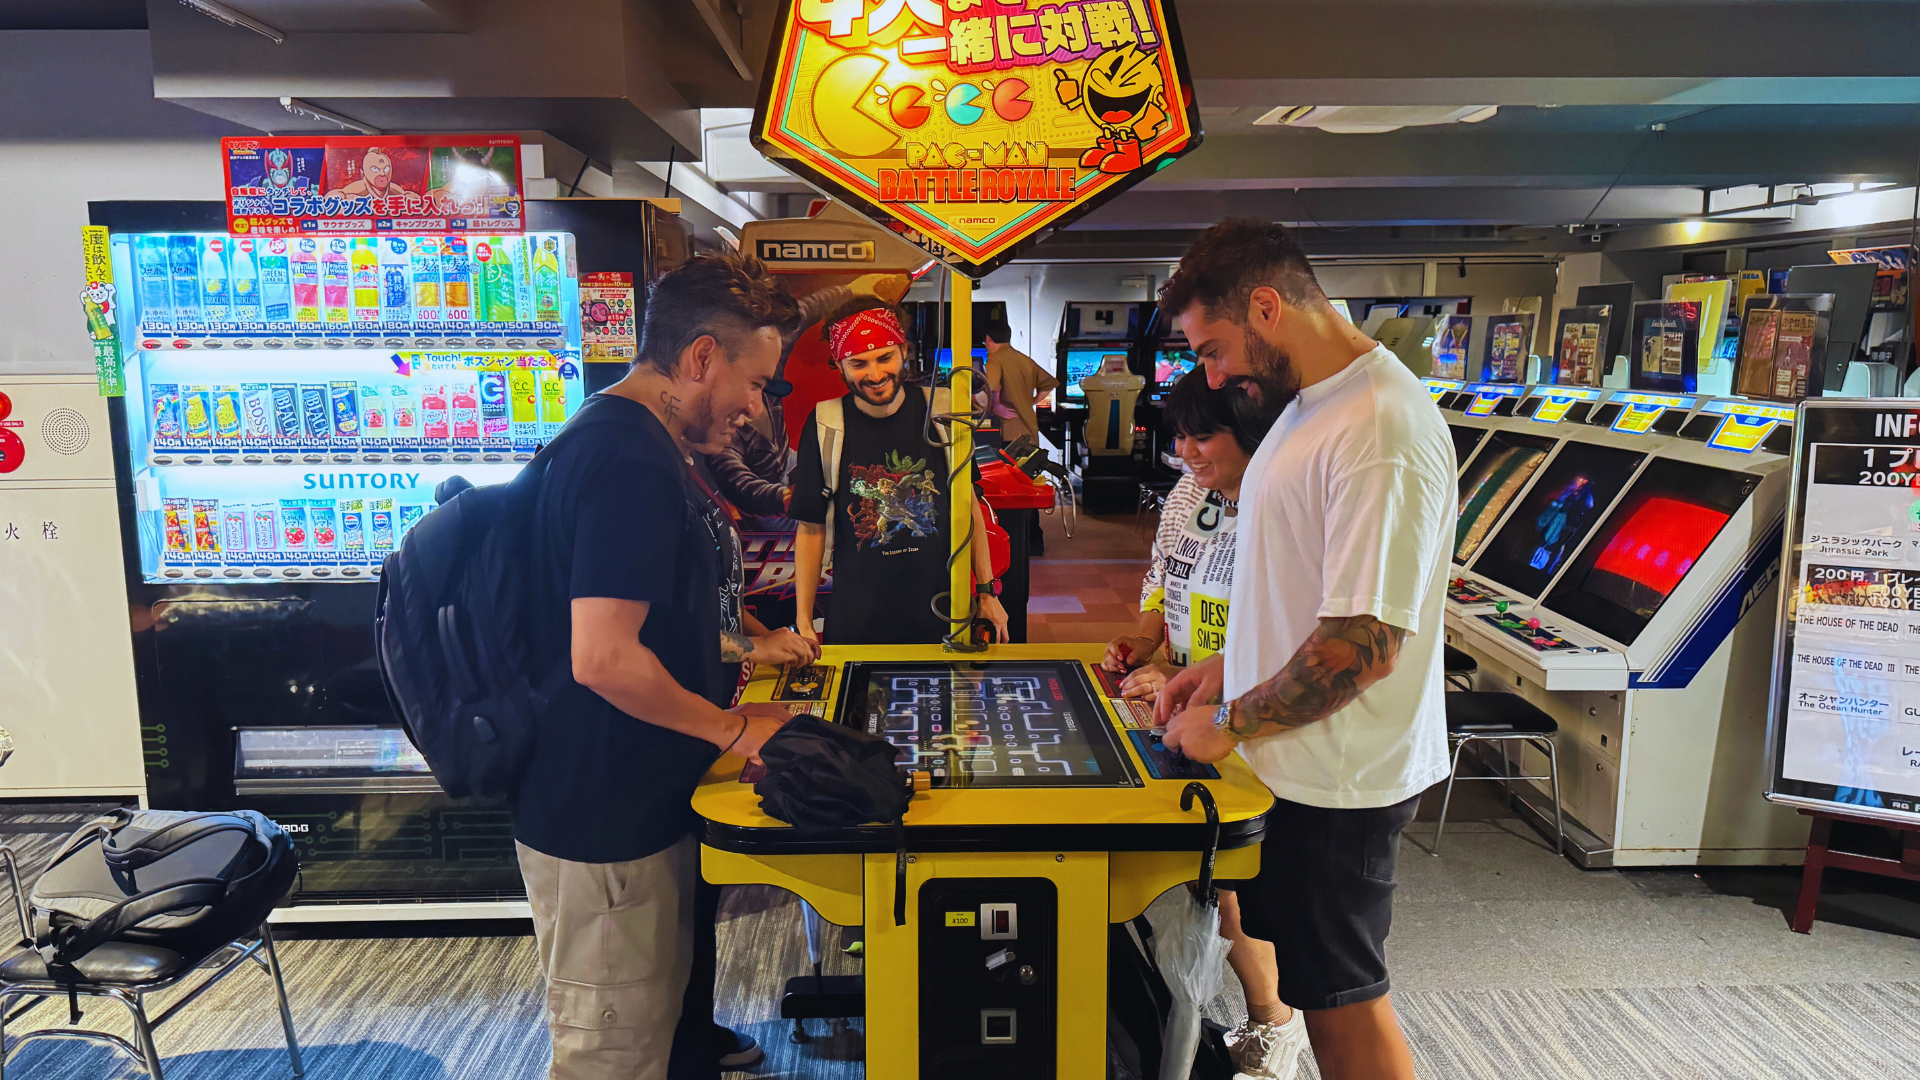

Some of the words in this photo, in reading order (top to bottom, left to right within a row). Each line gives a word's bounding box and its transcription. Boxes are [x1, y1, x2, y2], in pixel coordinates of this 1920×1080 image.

[902, 0, 1156, 64] 一緒に対戦!
[906, 141, 1049, 168] PAC-MAN
[879, 168, 979, 202] BATTLE
[980, 168, 1075, 202] ROYALE
[958, 215, 996, 225] namco
[763, 242, 867, 260] namco
[424, 353, 461, 363] Touch!
[463, 355, 552, 368] ボスジャン当たる!
[249, 397, 270, 434] BOSS
[276, 394, 299, 436] BLACK
[306, 395, 329, 437] BLACK
[1723, 403, 1759, 415] VIDEO
[1875, 413, 1920, 437] INF
[1889, 447, 1920, 468] プ
[304, 473, 420, 489] SUNTORY
[1810, 535, 1902, 548] ジュラシックパーク
[1819, 545, 1861, 555] Jurassic
[1865, 548, 1889, 557] Park
[1799, 614, 1814, 625] THE
[1816, 616, 1843, 627] HOUSE
[1845, 618, 1857, 629] OF
[1859, 619, 1875, 631] THE
[1877, 621, 1899, 633] DEAD
[1797, 653, 1810, 664] THE
[1812, 655, 1834, 666] HOUSE
[1836, 656, 1847, 667] OF
[1849, 659, 1862, 669] THE
[1864, 661, 1883, 671] DEAD
[1798, 700, 1815, 709] The
[1818, 702, 1847, 712] Ocean
[1851, 705, 1883, 716] Hunter
[1799, 692, 1889, 708] オーシャンハンター
[952, 917, 968, 925] ¥100
